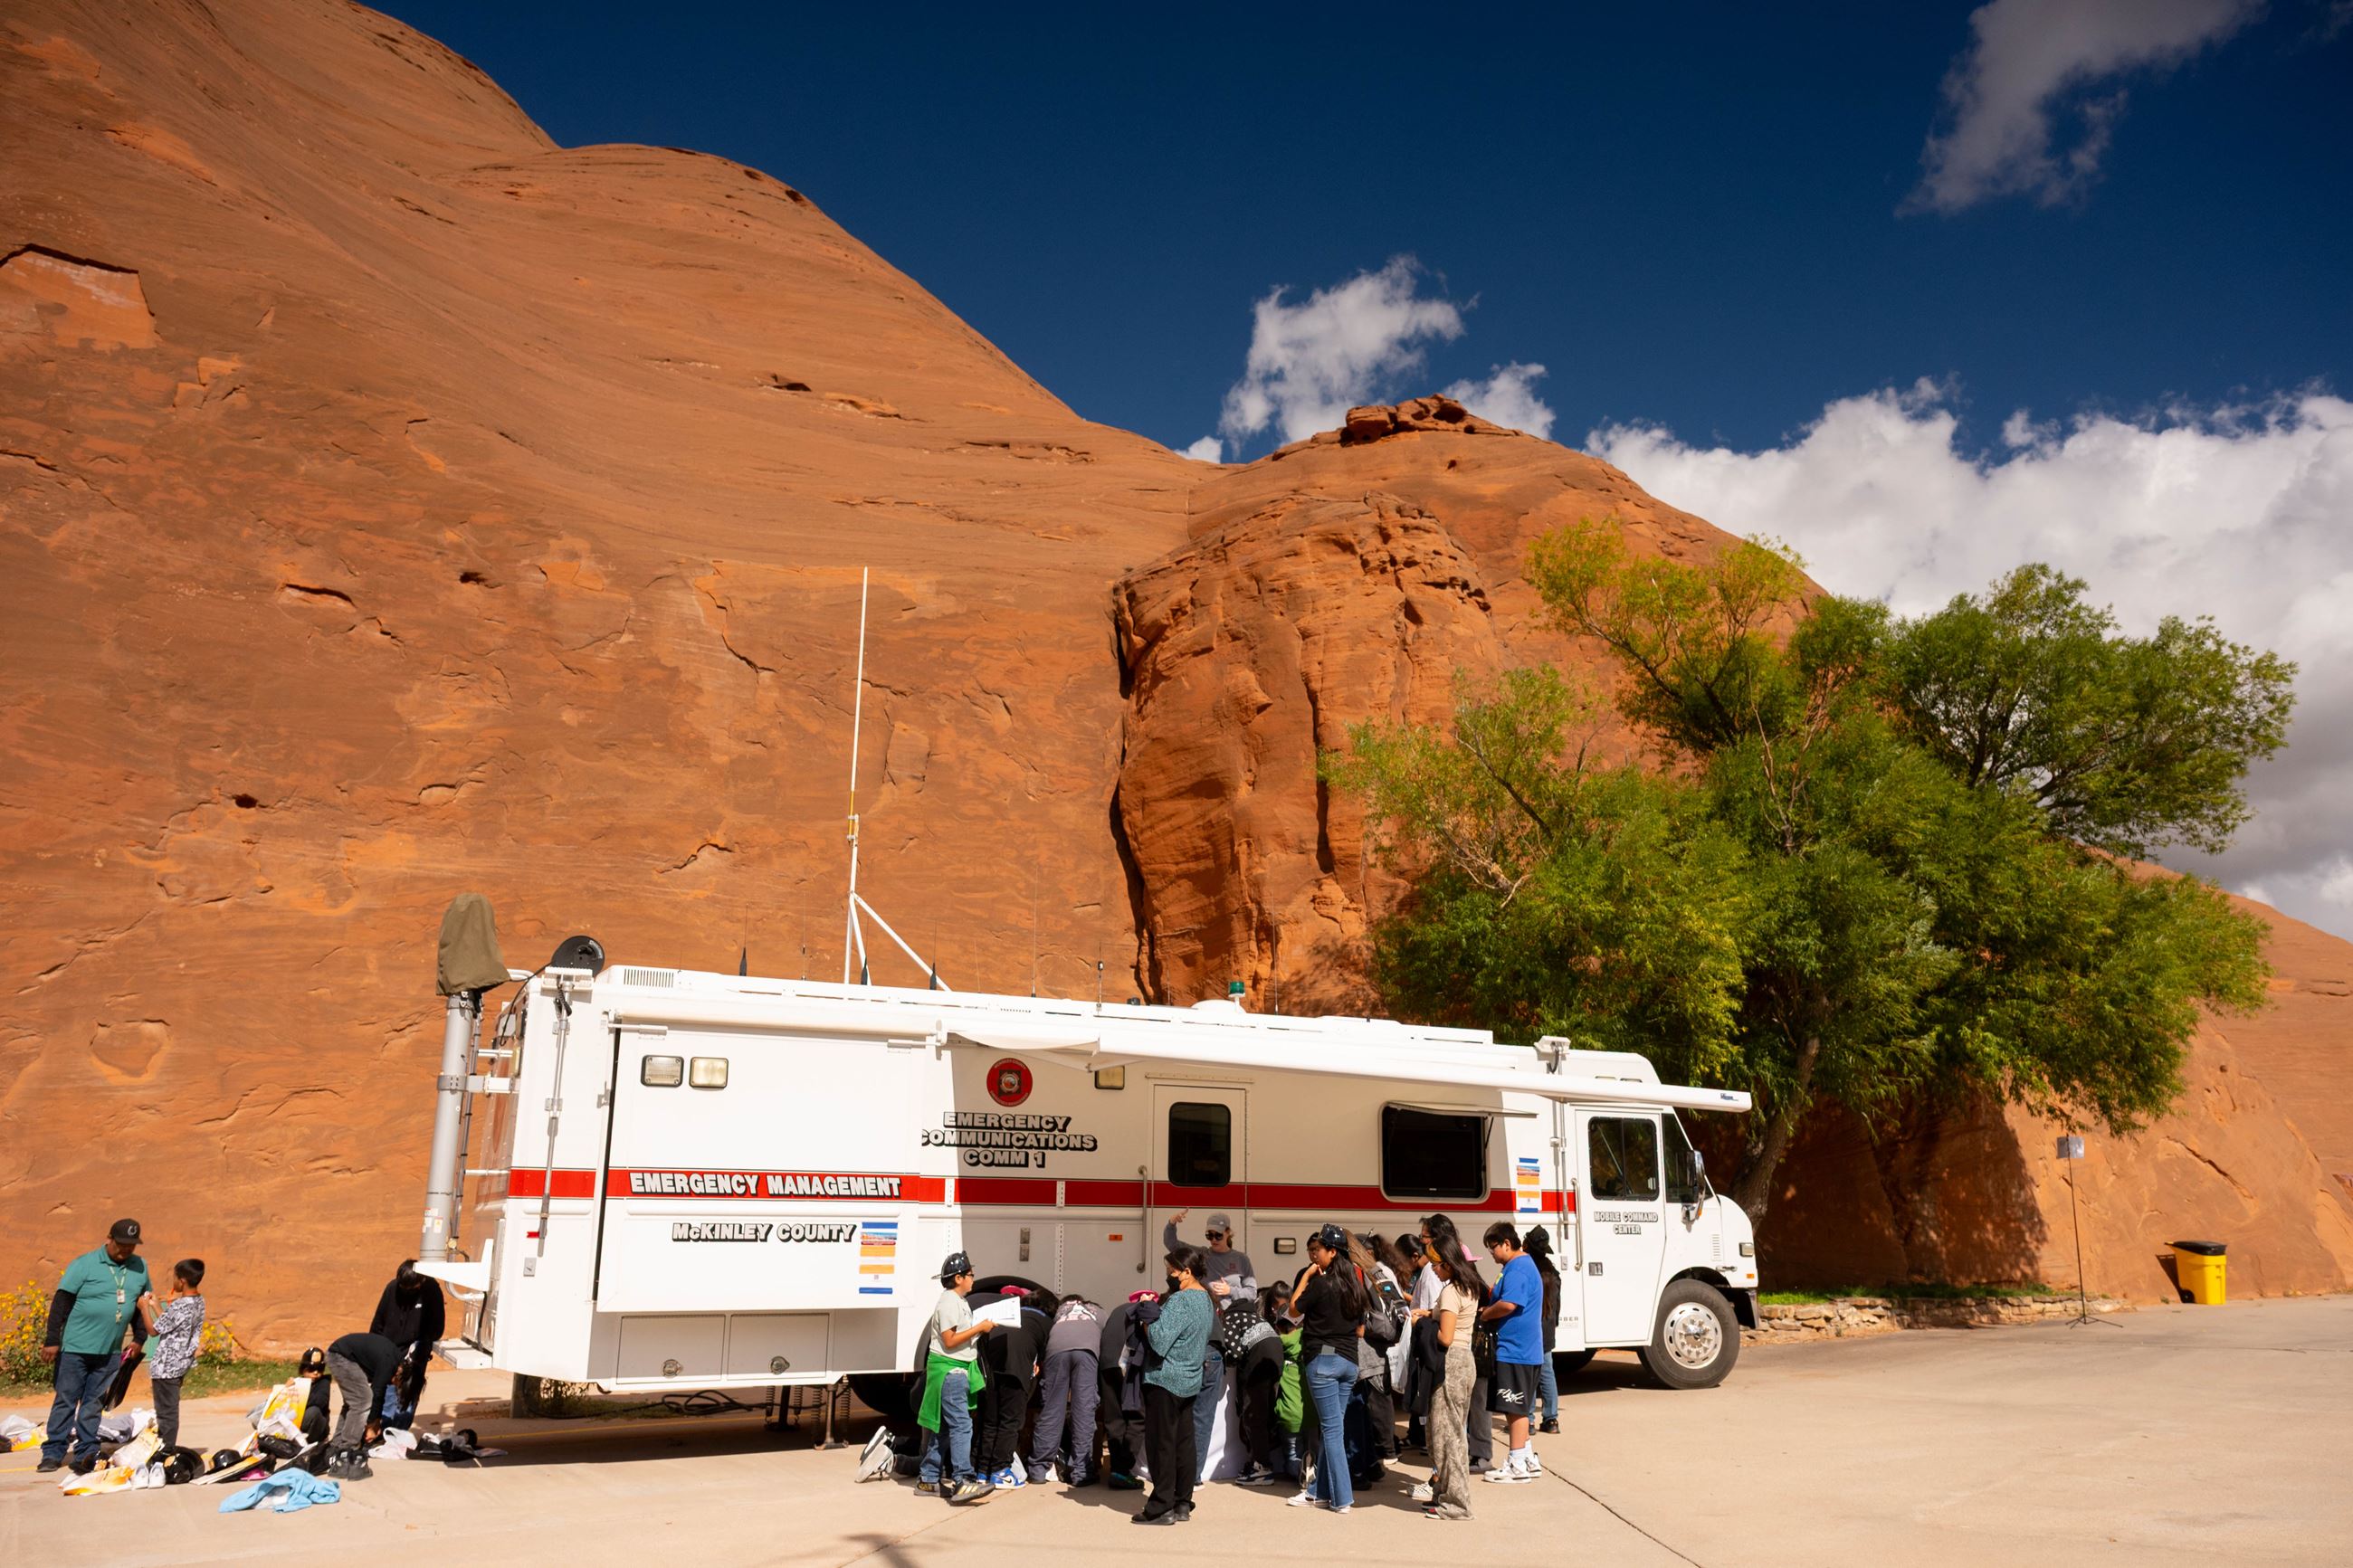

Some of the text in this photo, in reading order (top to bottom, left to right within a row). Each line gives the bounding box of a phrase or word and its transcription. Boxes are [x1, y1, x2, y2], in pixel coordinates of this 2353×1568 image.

[943, 1111, 1072, 1133] EMERGENCY
[921, 1129, 1098, 1152] COMMUNICATIONS
[963, 1149, 1046, 1168] COMM 1
[629, 1172, 901, 1198] EMERGENCY MANAGEMENT
[1594, 1211, 1659, 1223] MOBILE COMMAND
[672, 1222, 857, 1242] McKINLEY COUNTY
[1613, 1223, 1642, 1235] CENTER
